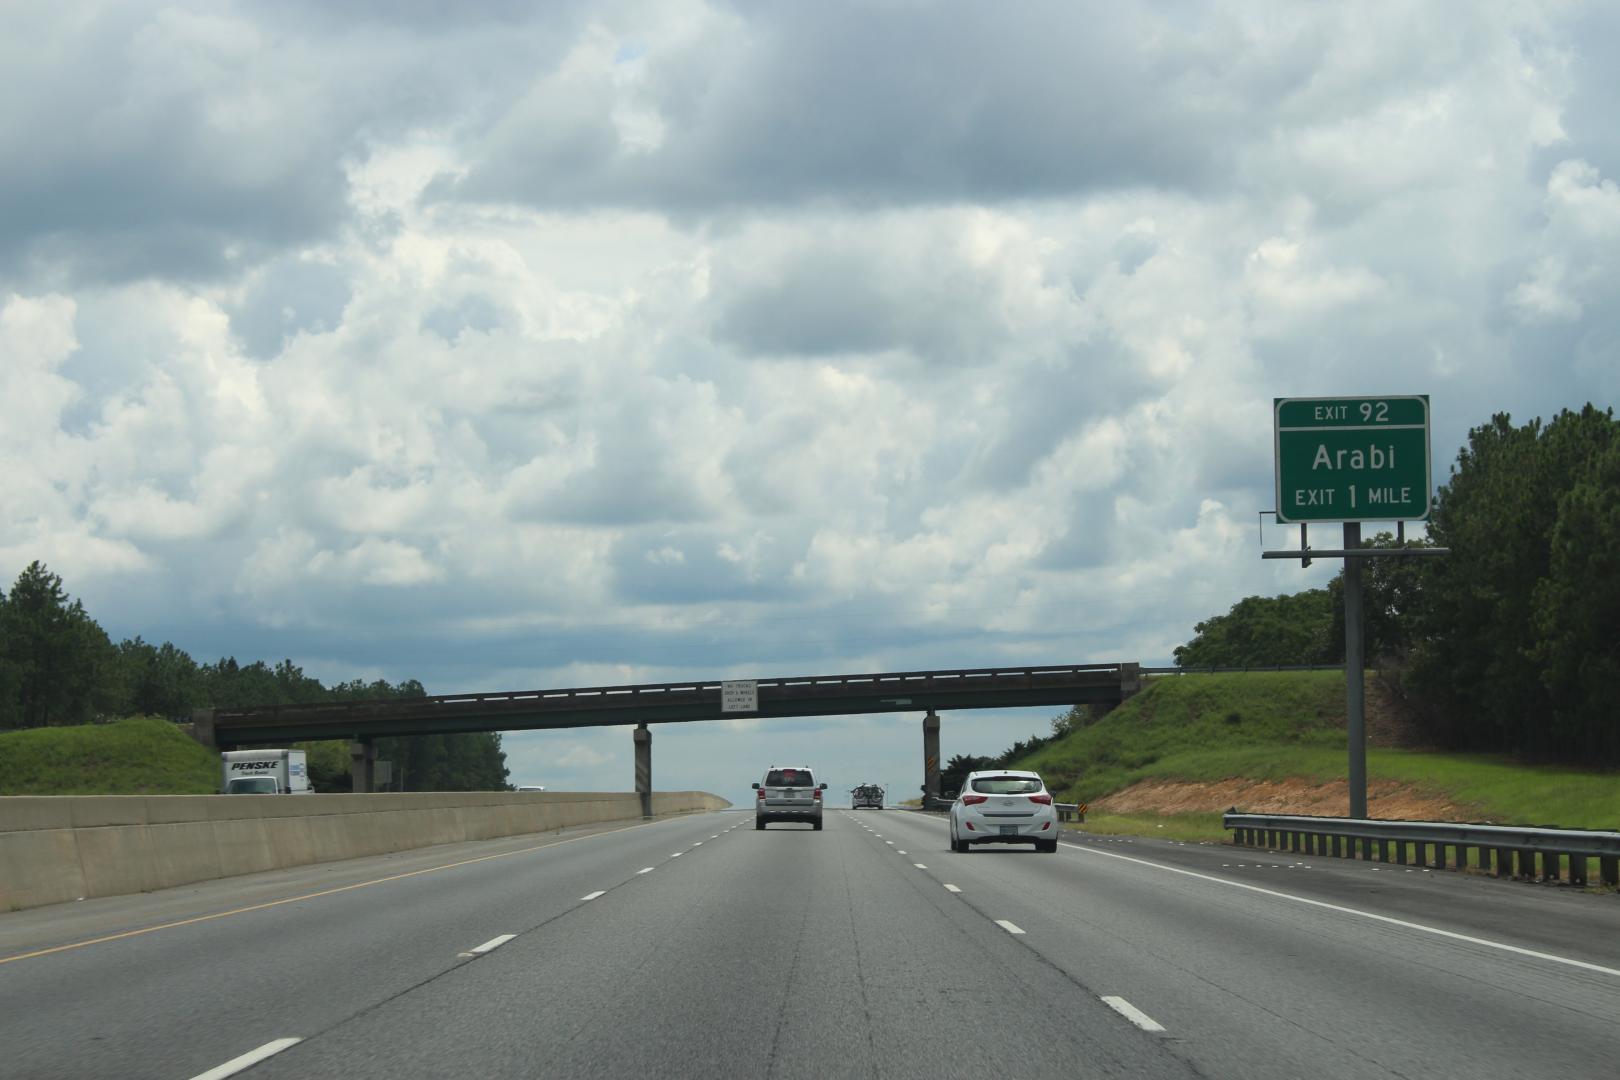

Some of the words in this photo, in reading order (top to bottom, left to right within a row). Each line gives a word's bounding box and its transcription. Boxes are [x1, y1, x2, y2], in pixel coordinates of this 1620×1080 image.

[1314, 405, 1348, 420] EXIT
[1359, 402, 1389, 422] 92
[1312, 444, 1395, 470] Arabi
[1295, 488, 1335, 506] EXIT
[1348, 485, 1356, 508] 1
[1368, 487, 1412, 504] MILE
[231, 761, 280, 770] PENSKE
